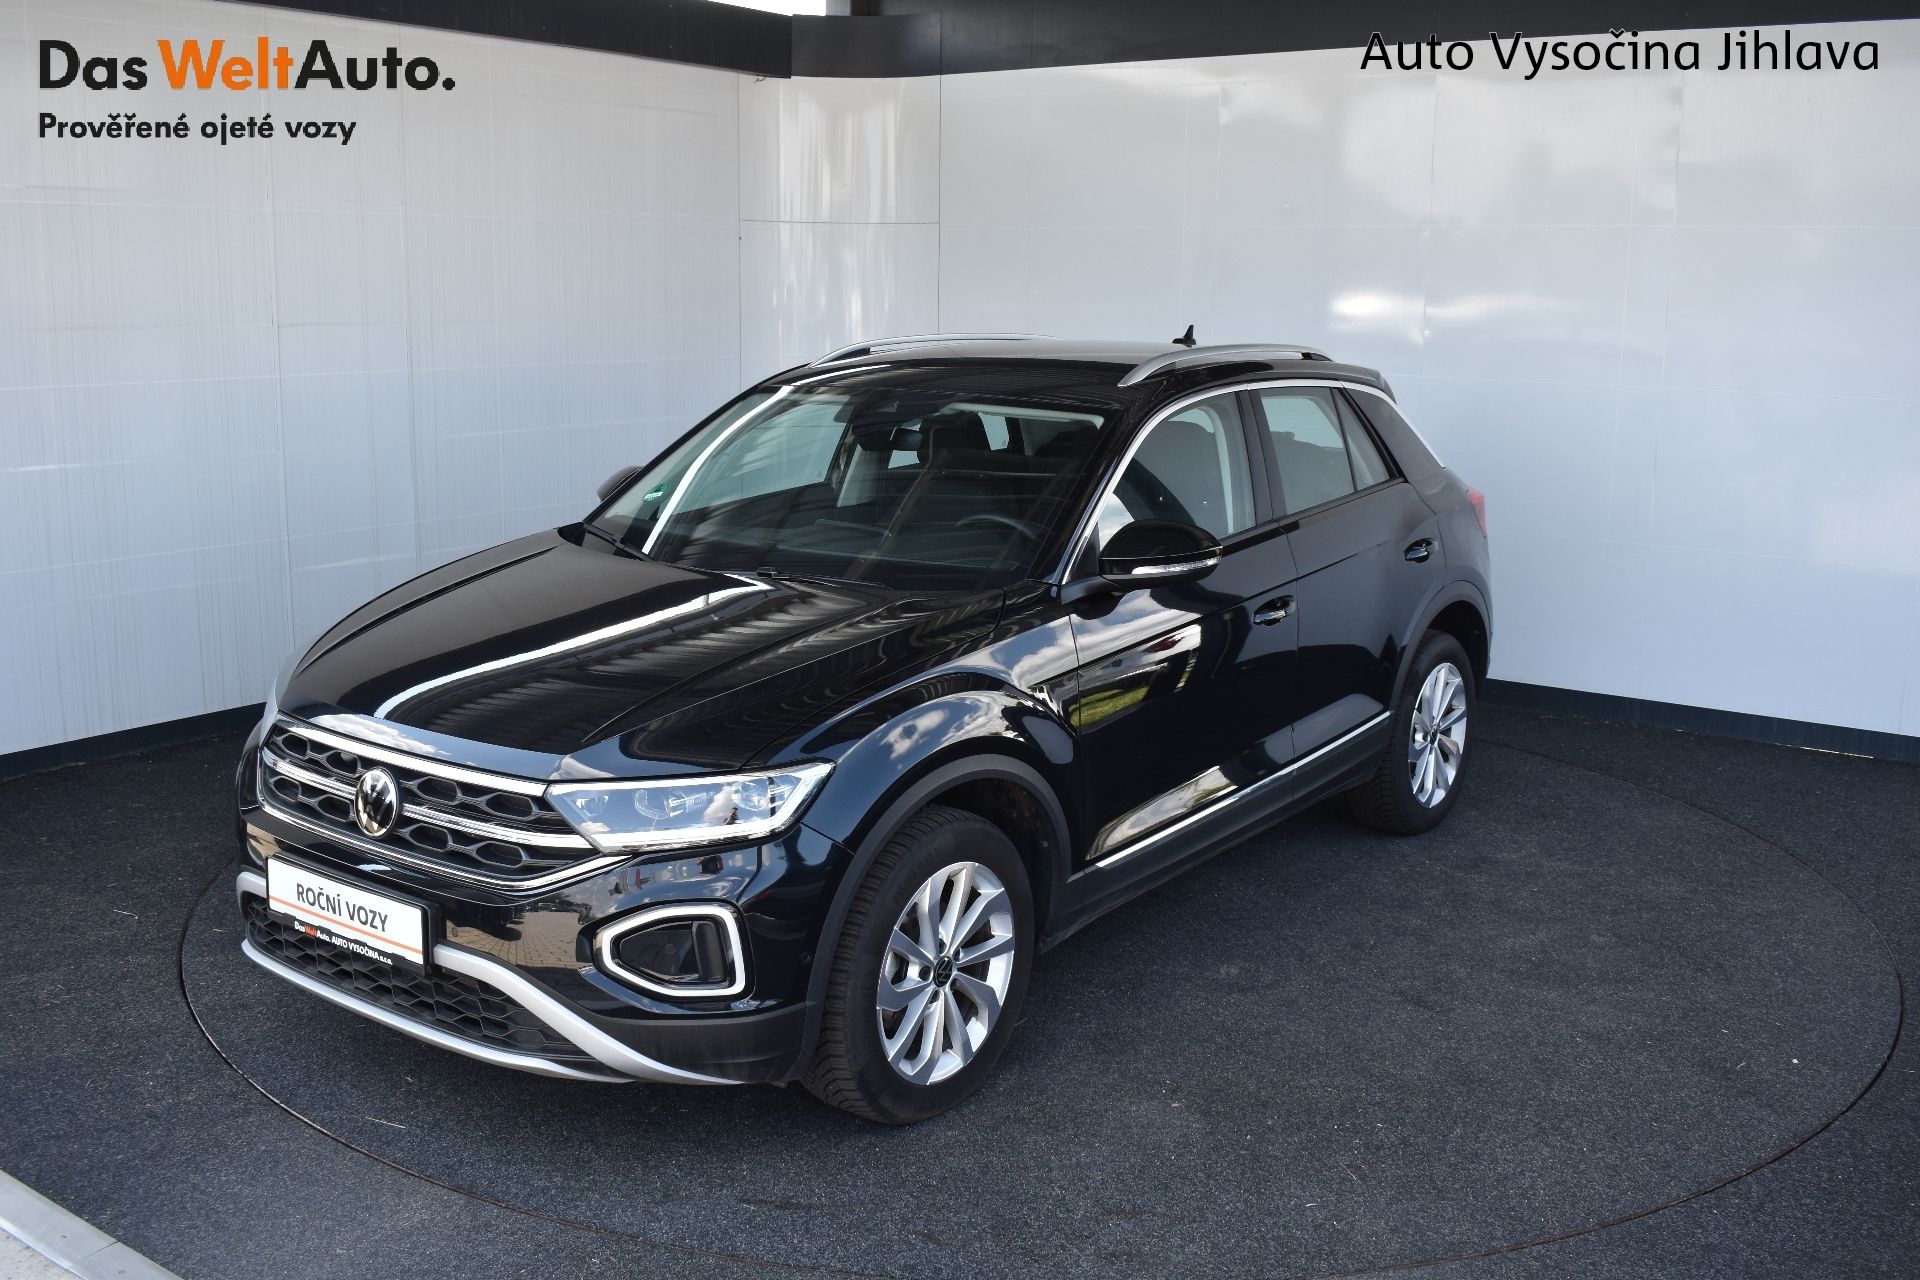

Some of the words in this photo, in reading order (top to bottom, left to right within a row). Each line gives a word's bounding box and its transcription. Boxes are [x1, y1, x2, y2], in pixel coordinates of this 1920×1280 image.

[296, 883, 342, 916] ROČNÍ
[345, 901, 389, 933] VOZY
[331, 935, 348, 948] AUTO
[348, 941, 380, 961] VYSOČINA
